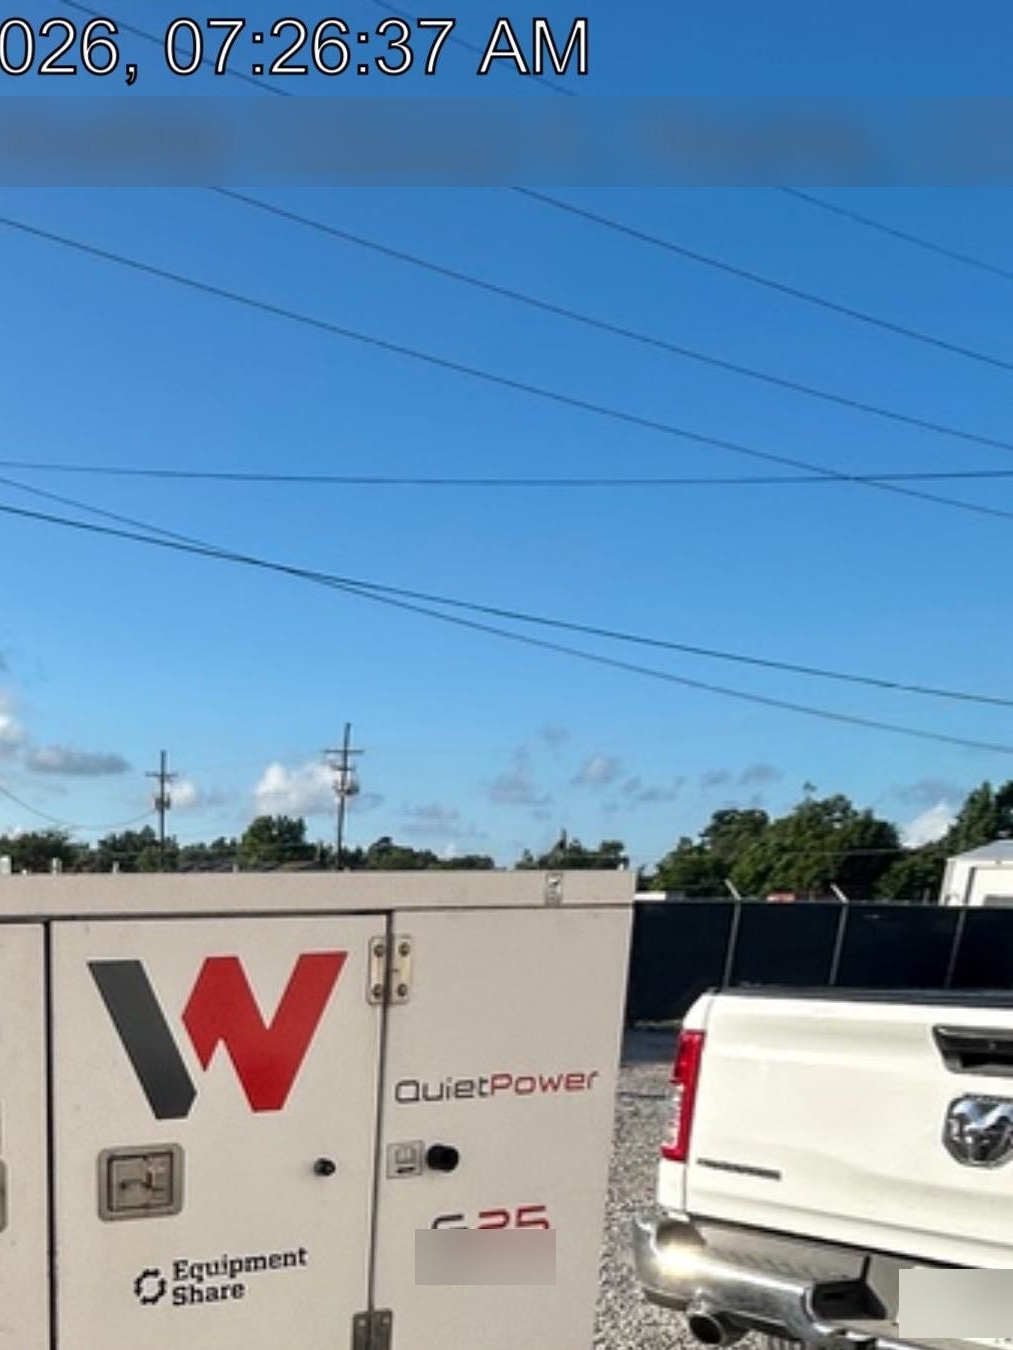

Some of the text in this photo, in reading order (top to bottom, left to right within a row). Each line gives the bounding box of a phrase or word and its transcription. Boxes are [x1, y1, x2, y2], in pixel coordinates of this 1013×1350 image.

[394, 1070, 599, 1104] QuietPower
[172, 1247, 309, 1283] Equipment
[172, 1283, 246, 1306] Share
